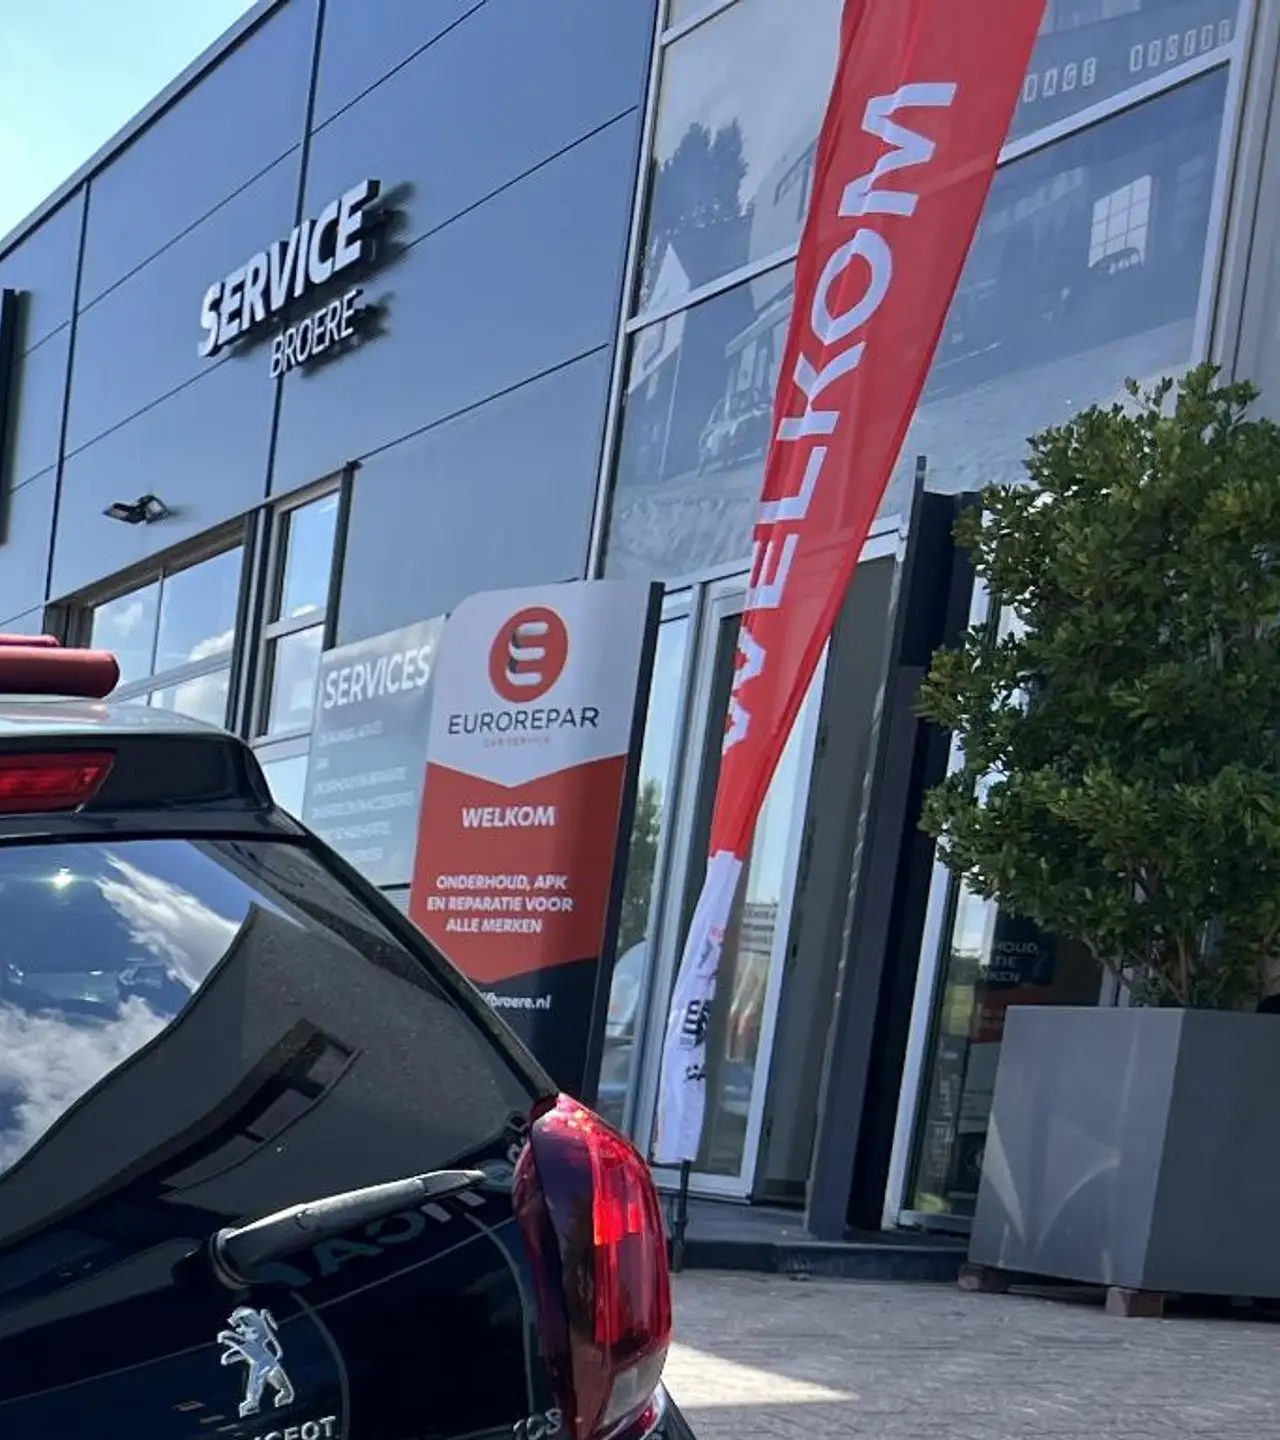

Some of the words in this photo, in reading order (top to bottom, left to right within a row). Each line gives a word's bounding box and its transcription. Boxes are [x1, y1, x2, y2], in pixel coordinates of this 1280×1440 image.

[198, 179, 380, 357] SERVICE
[269, 289, 364, 378] BROERE
[722, 82, 957, 757] WELKOM
[323, 645, 431, 709] SERVICES
[448, 706, 600, 735] EUROREPAR
[461, 806, 556, 828] WELKOM
[436, 874, 530, 891] ONDERHOUD,
[534, 875, 567, 890] APK
[427, 896, 445, 911] EN
[448, 896, 522, 911] REPARATIE
[525, 897, 573, 911] VOOR
[445, 918, 479, 932] ALLE
[481, 918, 543, 933] MERKEN
